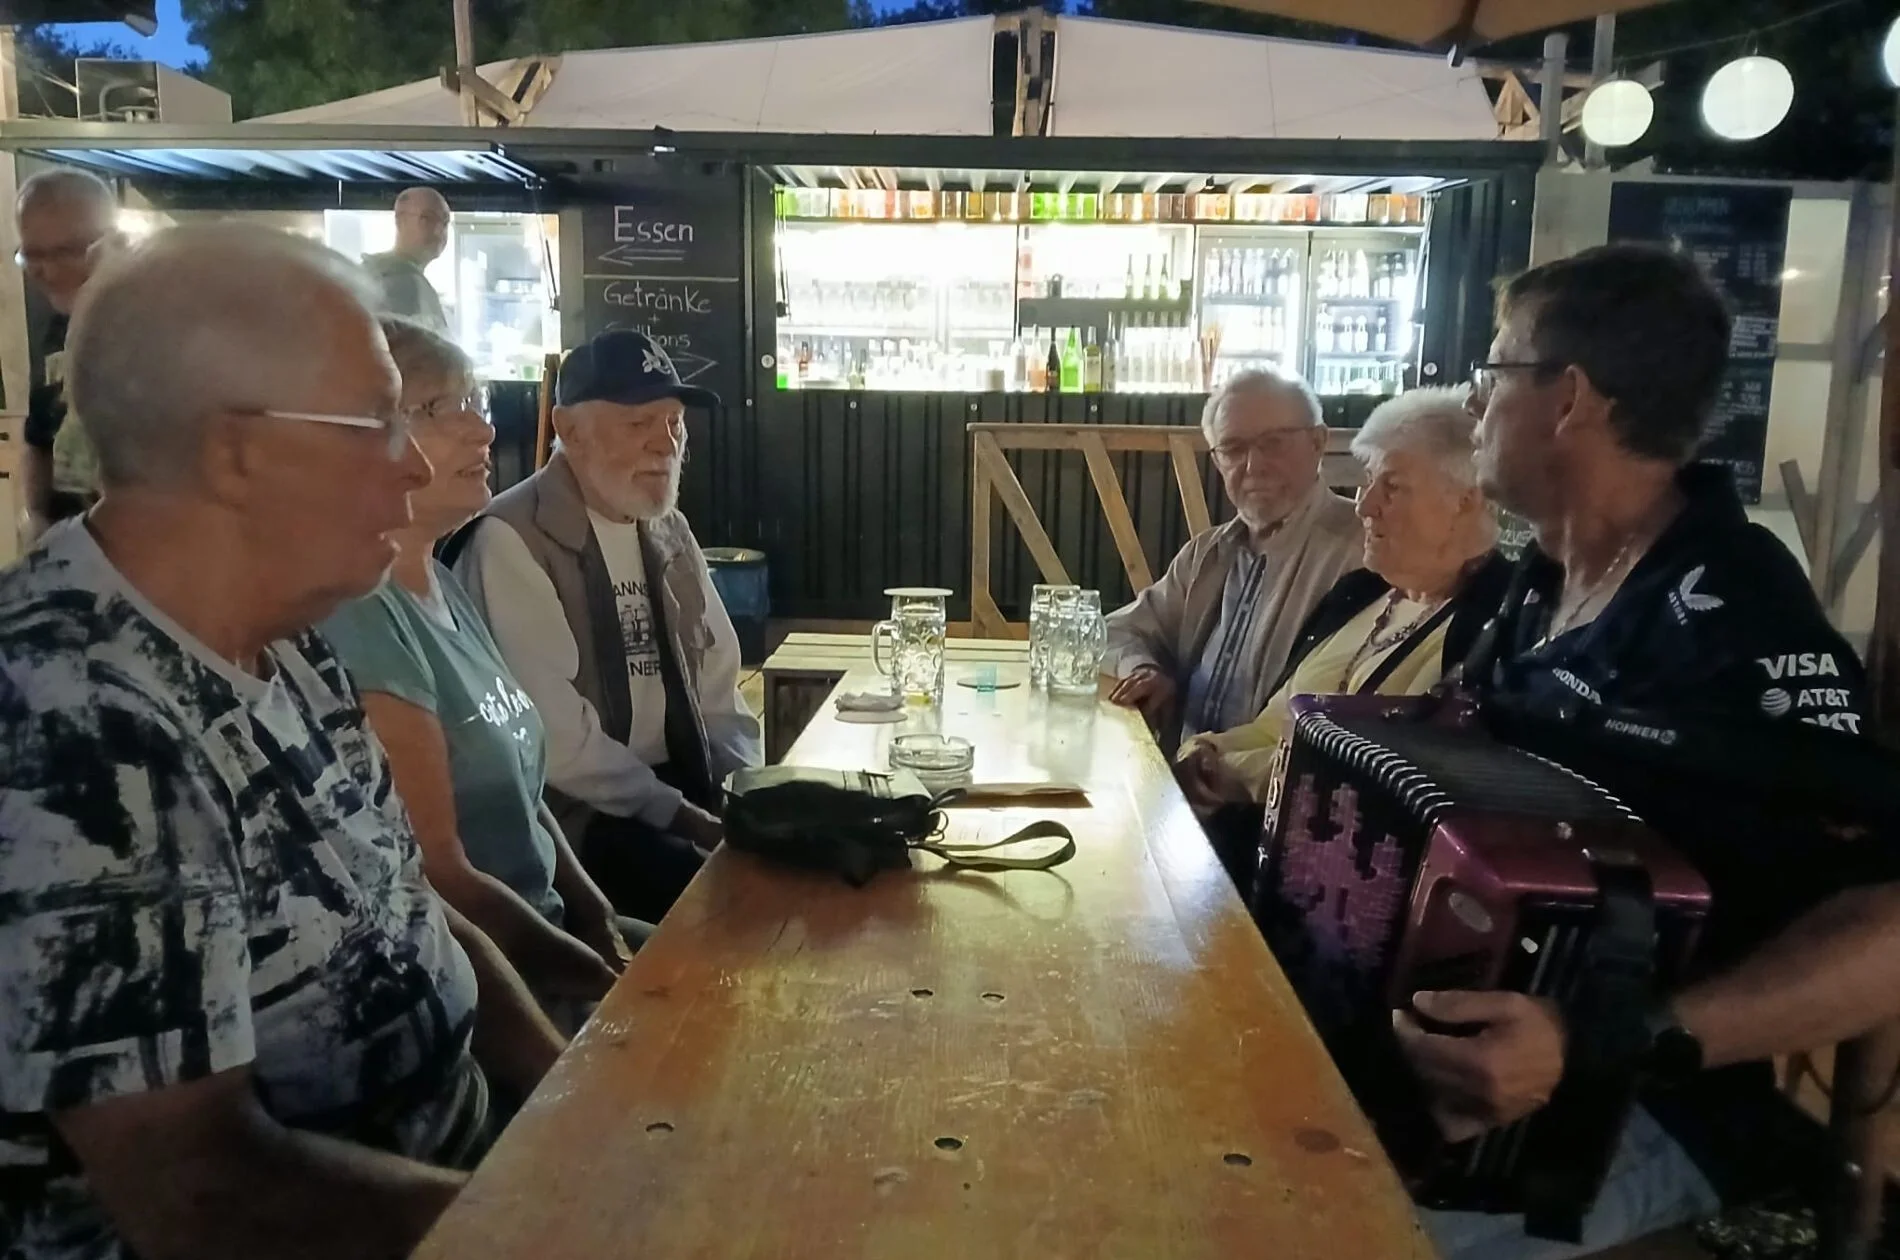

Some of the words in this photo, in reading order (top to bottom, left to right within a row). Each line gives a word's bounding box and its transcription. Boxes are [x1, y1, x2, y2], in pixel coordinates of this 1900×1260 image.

[614, 205, 693, 242] Essen
[603, 281, 712, 313] Getränke
[1756, 652, 1840, 679] VISA
[1797, 688, 1850, 707] AT&T
